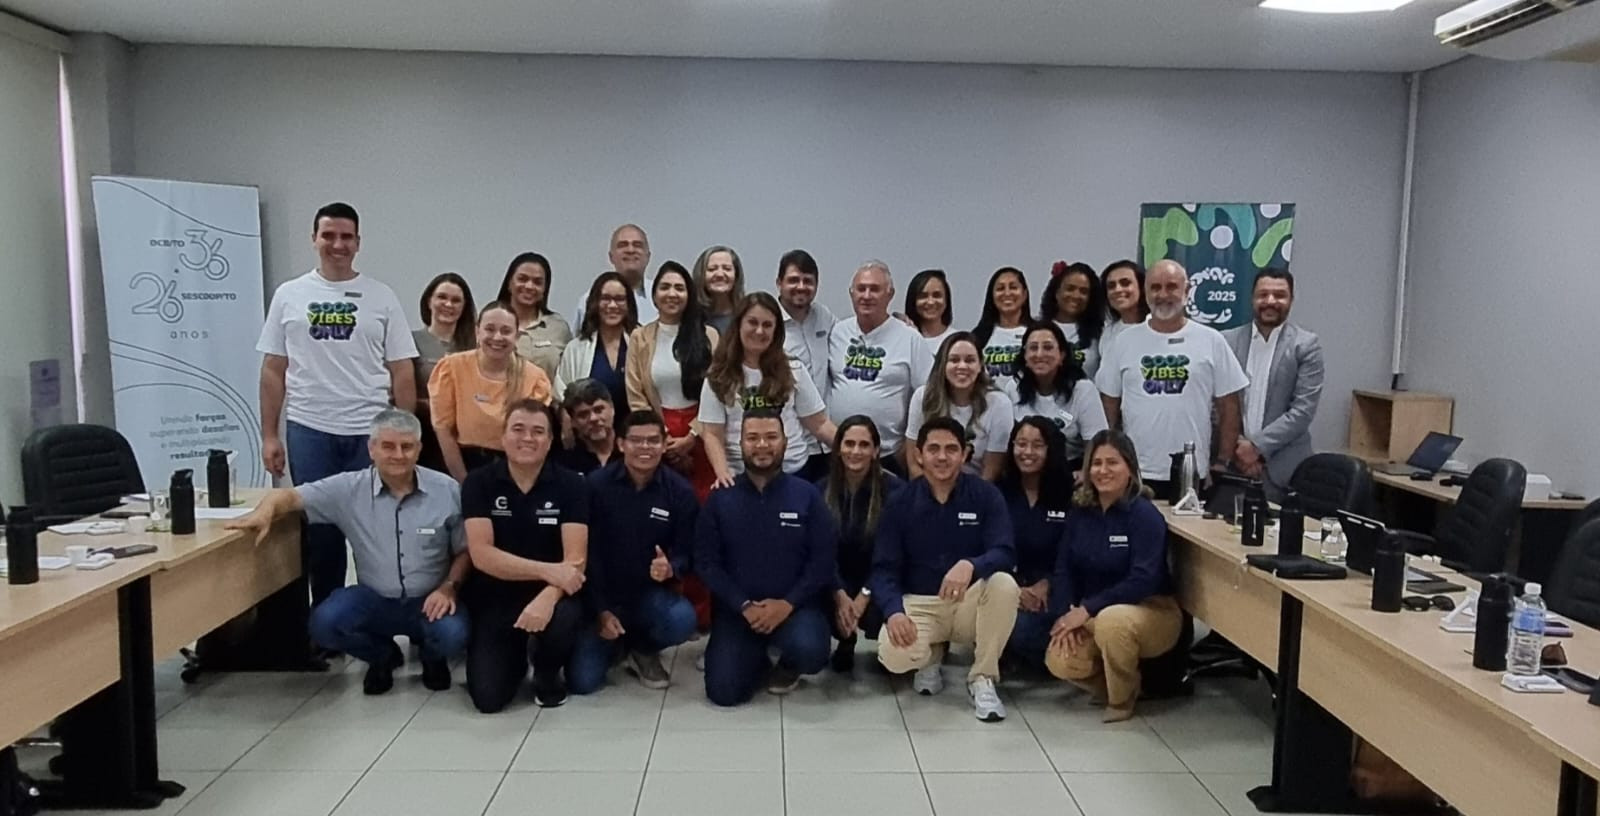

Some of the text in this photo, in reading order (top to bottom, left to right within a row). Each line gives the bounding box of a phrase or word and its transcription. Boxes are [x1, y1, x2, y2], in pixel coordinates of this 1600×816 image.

[179, 229, 230, 281] 36
[129, 271, 184, 324] 26
[1207, 290, 1237, 302] 2025
[307, 312, 356, 325] VIBES
[170, 331, 209, 340] anos
[844, 355, 883, 370] VIBES
[1140, 366, 1189, 381] VIBES
